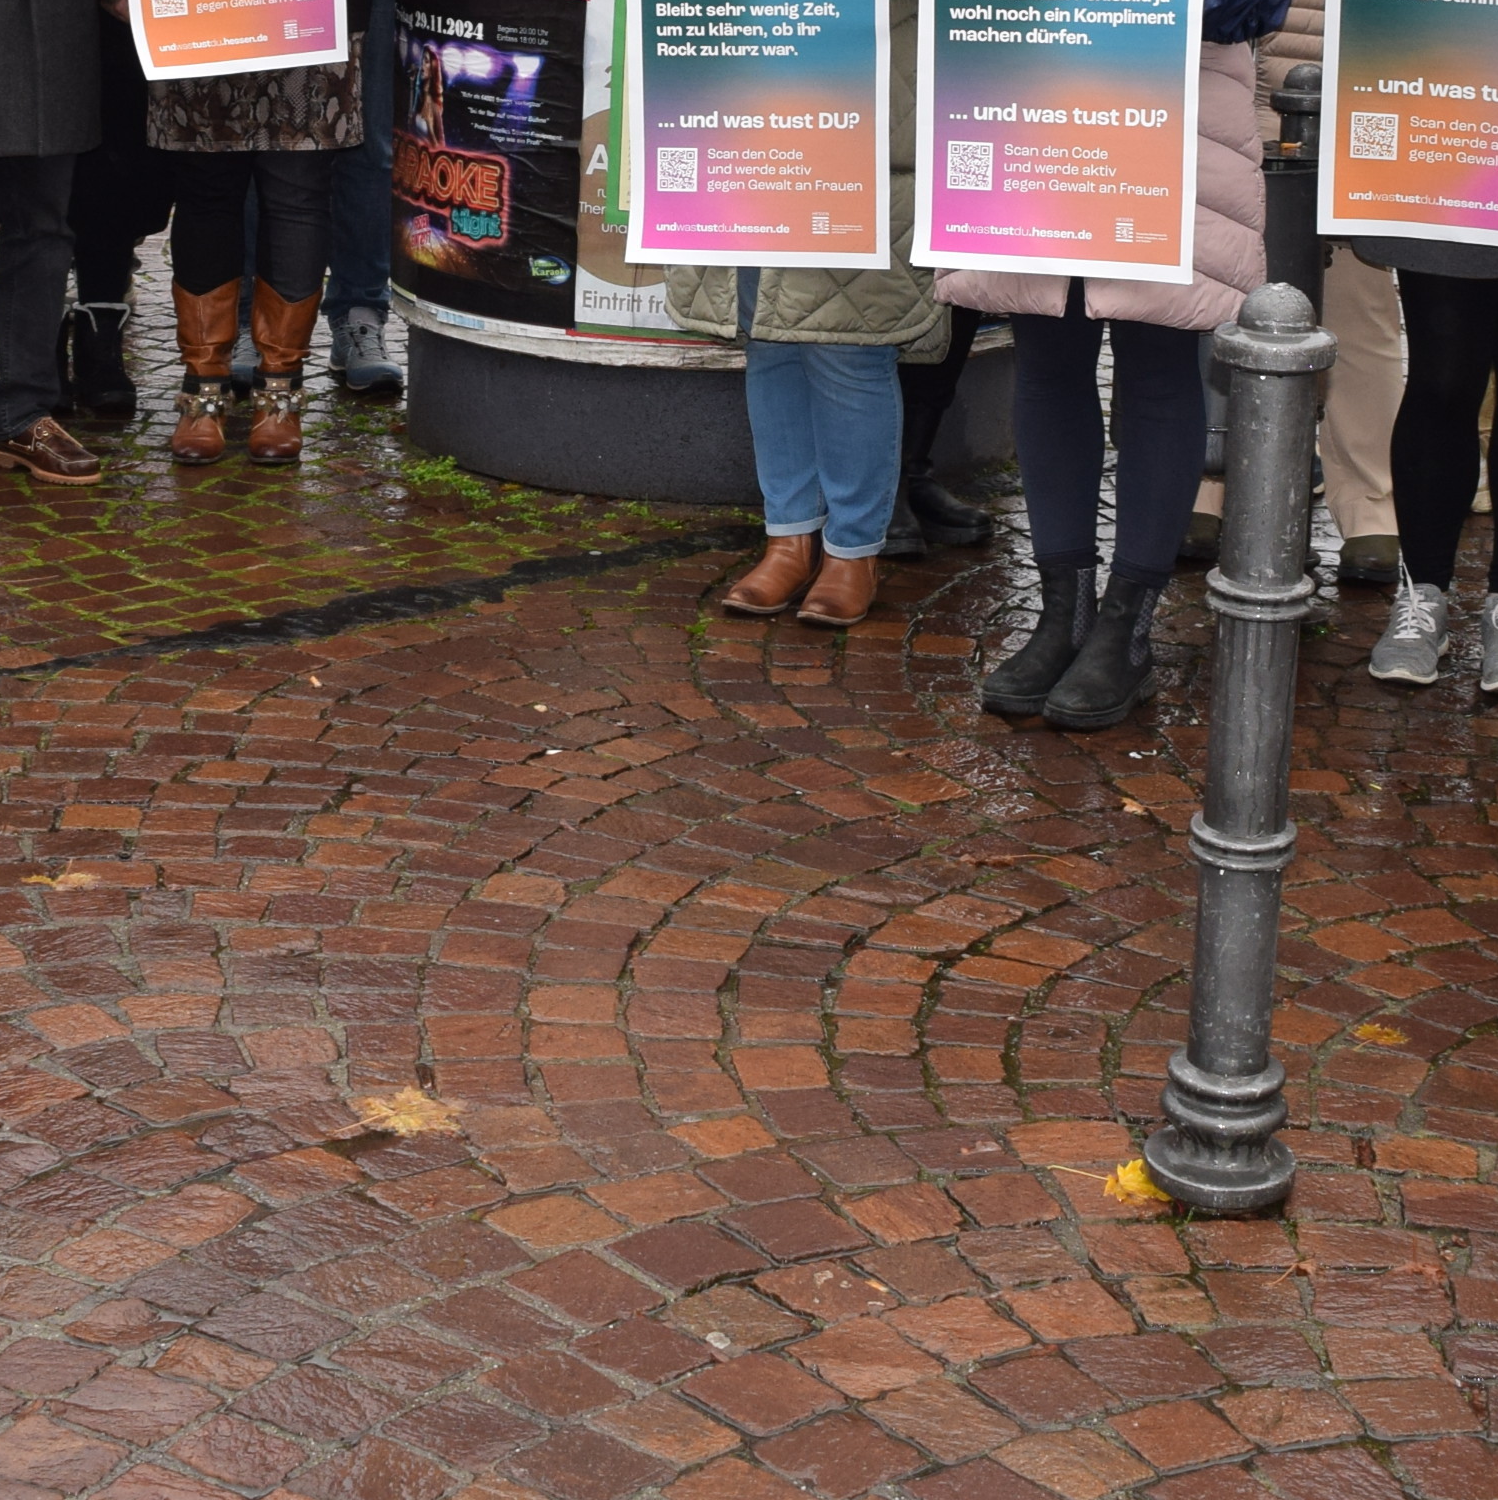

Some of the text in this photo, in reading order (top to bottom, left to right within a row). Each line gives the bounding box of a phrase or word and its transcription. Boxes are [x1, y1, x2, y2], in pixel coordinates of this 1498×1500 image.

[196, 1, 228, 14] gegen
[414, 10, 484, 40] 29.11.2024
[497, 25, 548, 36] Beginn 20:00 Uhr
[520, 36, 536, 44] 18:00
[537, 37, 548, 45] Uhr
[708, 148, 803, 160] Scan den Code
[582, 290, 642, 312] Eintritt
